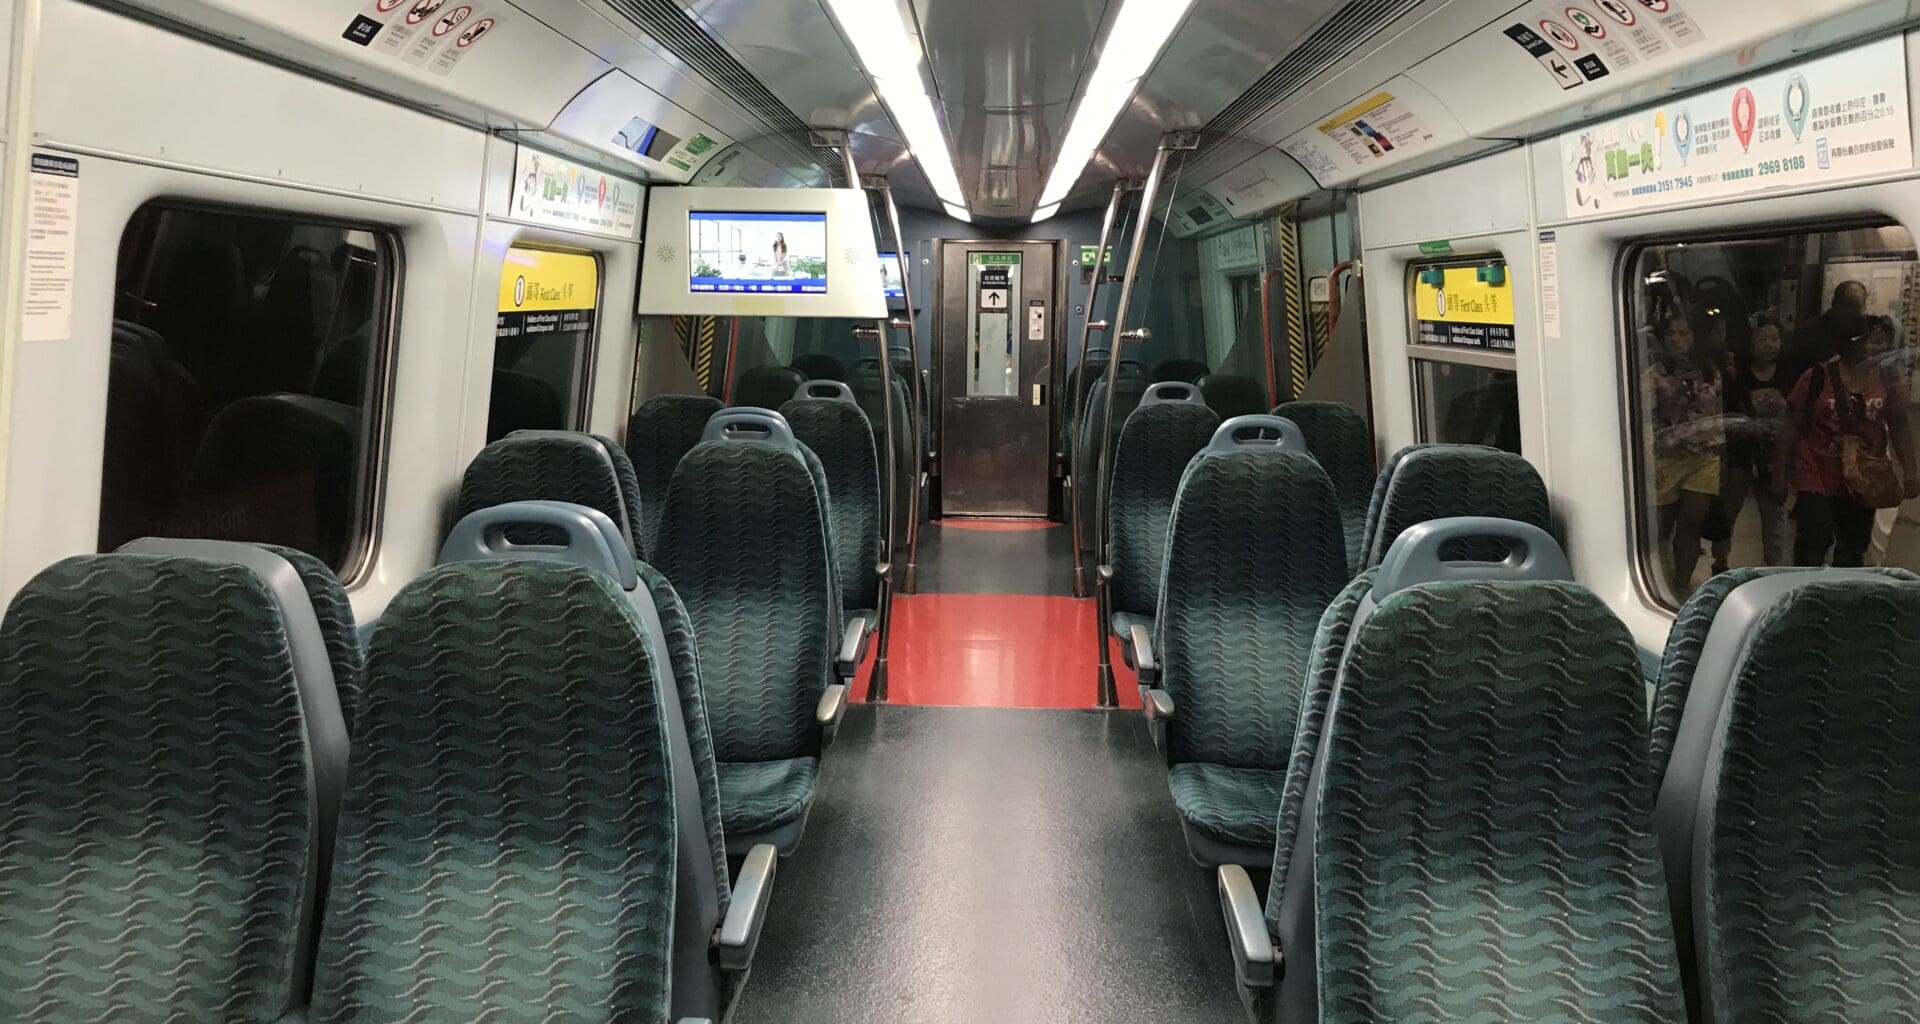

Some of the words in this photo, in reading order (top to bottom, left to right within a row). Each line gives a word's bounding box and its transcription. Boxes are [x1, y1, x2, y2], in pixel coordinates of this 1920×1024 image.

[1758, 159, 1781, 176] 2969
[1783, 155, 1805, 172] 8188
[1657, 180, 1674, 192] 3151
[1674, 176, 1693, 190] 7945
[540, 287, 550, 301] First
[550, 288, 561, 301] Class
[1460, 299, 1471, 312] First
[1471, 300, 1483, 313] Class
[1828, 397, 1884, 411] TYO
